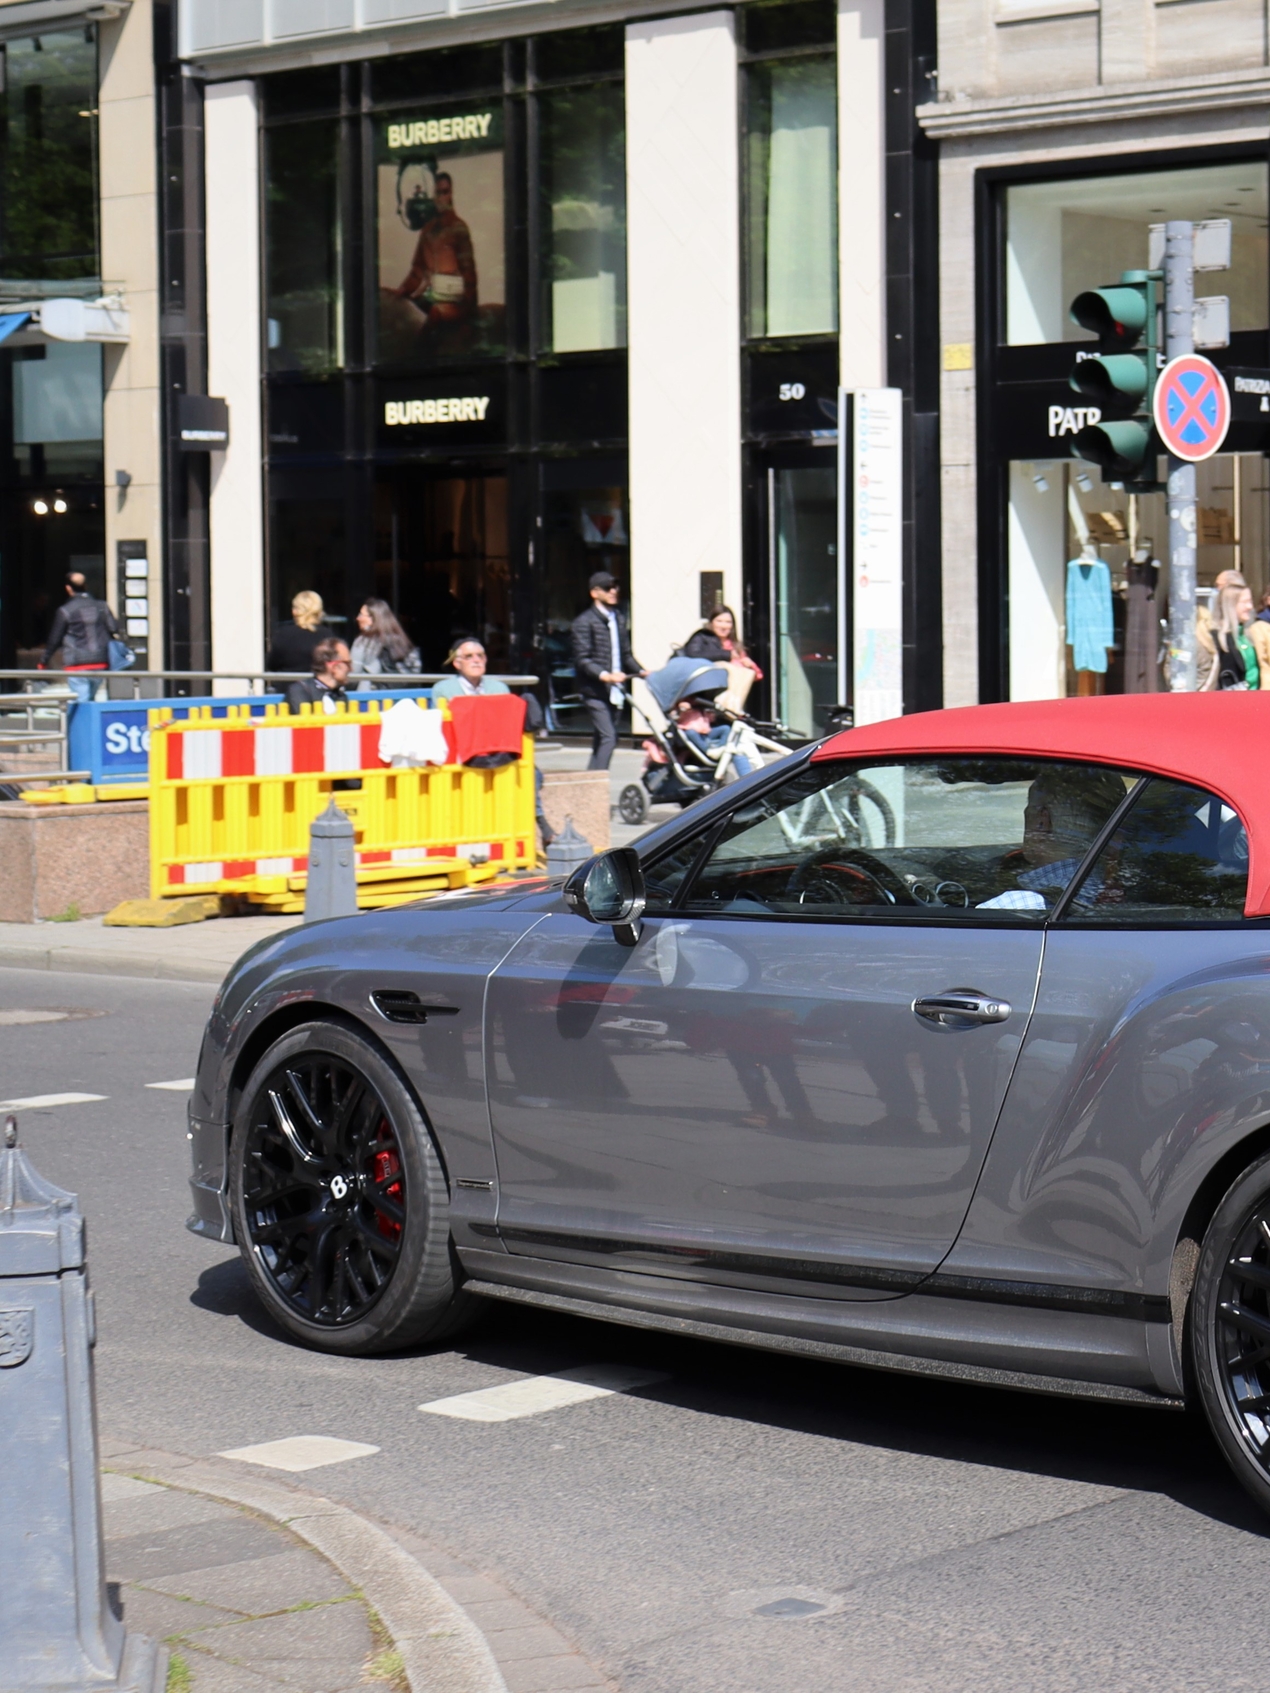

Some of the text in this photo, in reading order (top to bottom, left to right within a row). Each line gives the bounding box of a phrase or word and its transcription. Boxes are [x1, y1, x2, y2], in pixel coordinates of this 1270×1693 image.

[388, 113, 492, 148] BURBERRY
[779, 383, 806, 401] 50
[385, 396, 490, 426] BURBERRY
